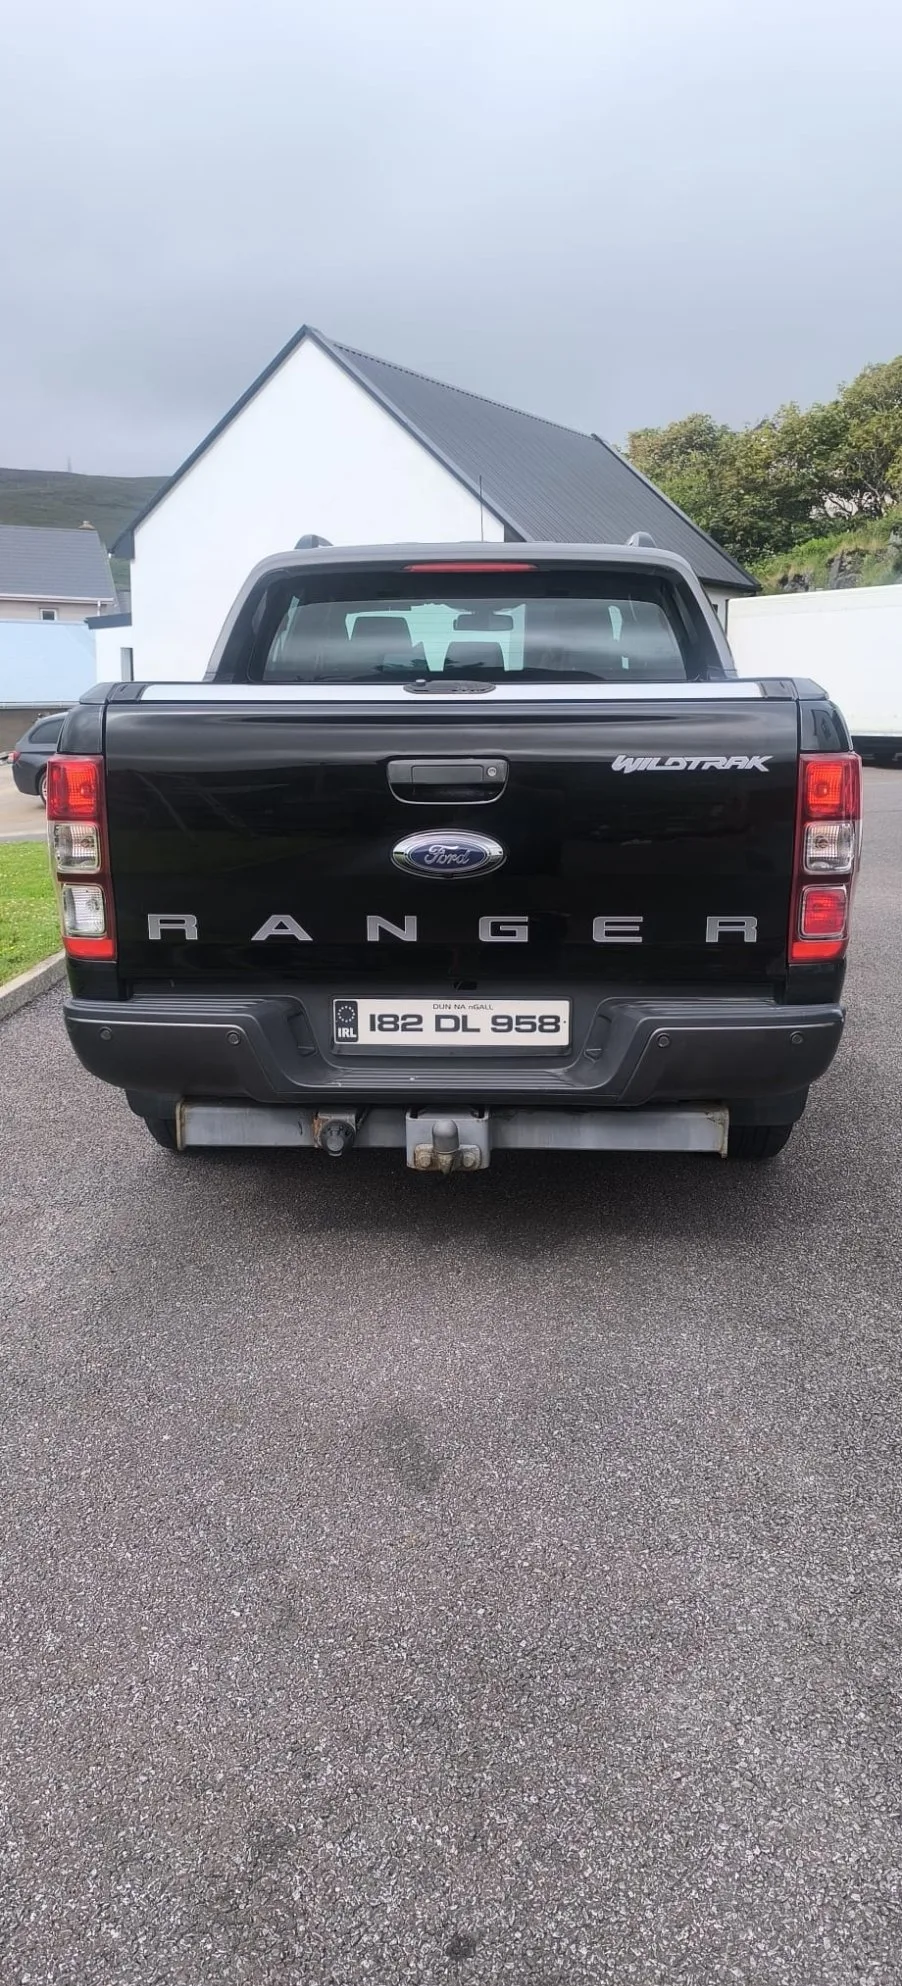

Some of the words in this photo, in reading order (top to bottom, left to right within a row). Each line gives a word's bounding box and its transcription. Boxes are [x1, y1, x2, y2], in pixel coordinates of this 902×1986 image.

[611, 755, 773, 774] WILDTRAK
[424, 844, 470, 865] Ford
[147, 913, 758, 942] RANGER
[337, 1027, 357, 1038] IRL
[369, 1014, 423, 1032] 182
[435, 1015, 481, 1033] DL
[490, 1015, 561, 1033] 958
